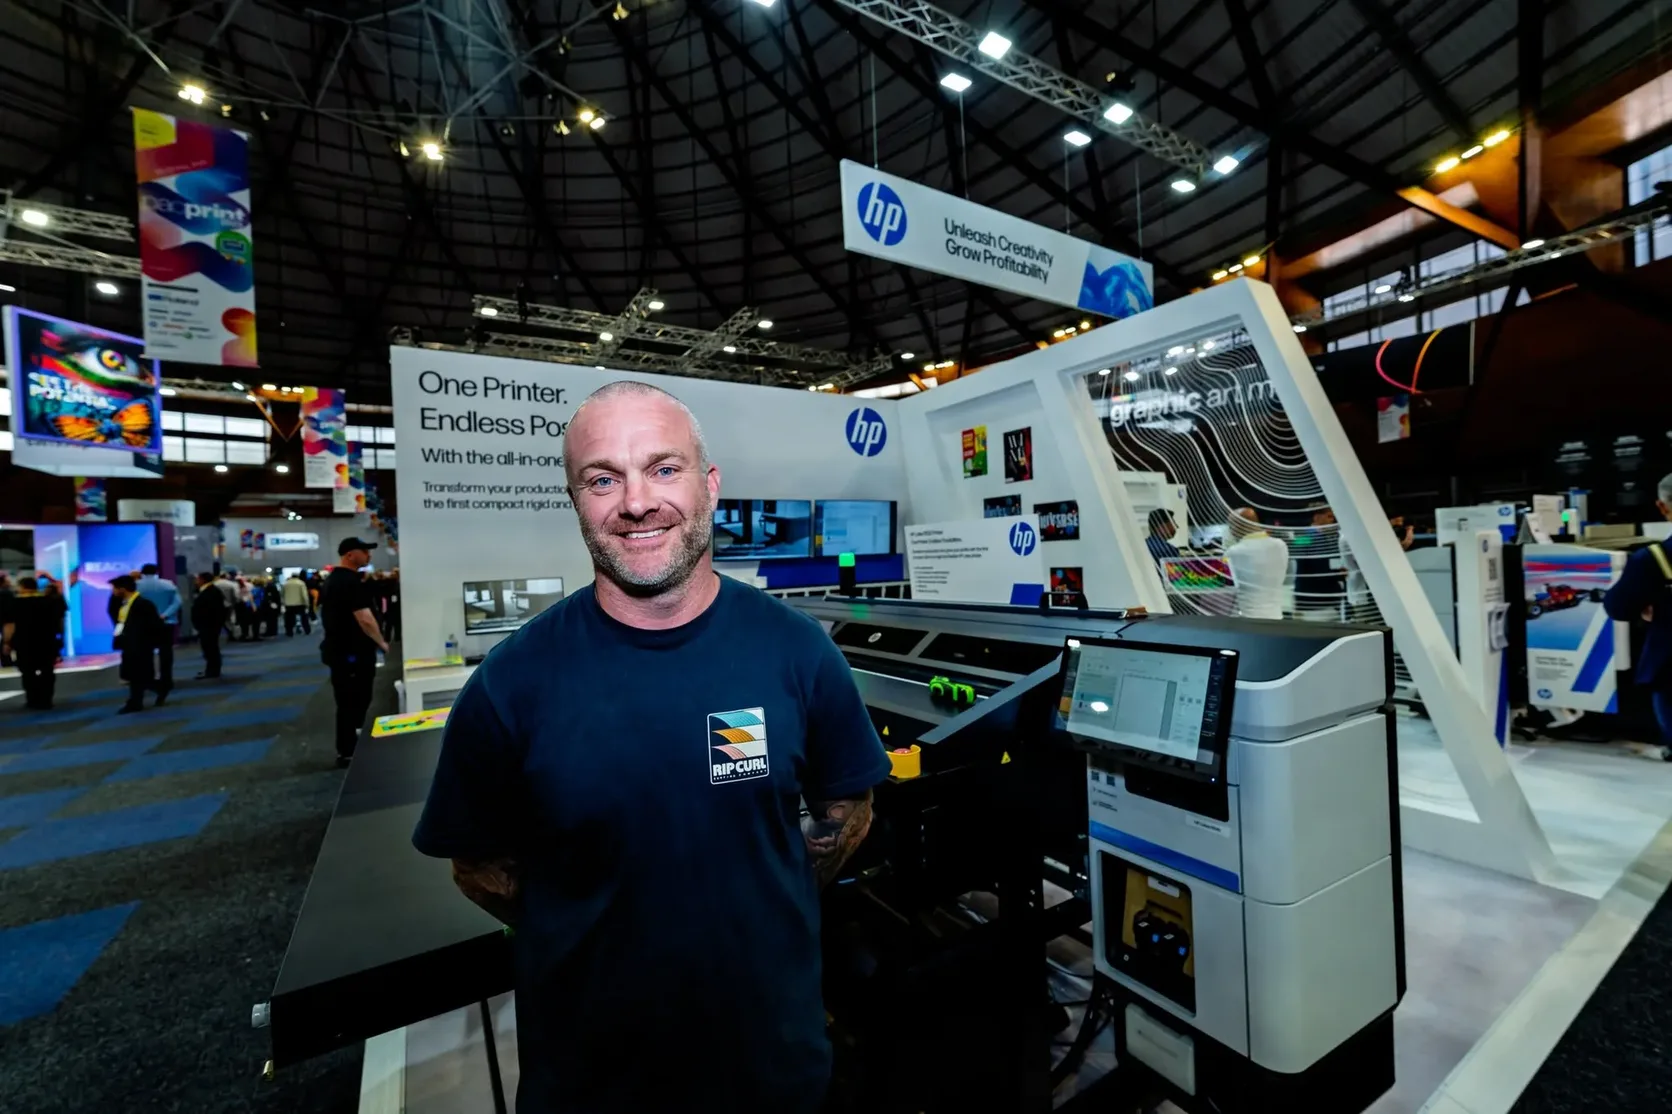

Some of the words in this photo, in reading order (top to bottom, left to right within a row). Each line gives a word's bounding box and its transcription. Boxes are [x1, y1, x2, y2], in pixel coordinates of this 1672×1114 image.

[859, 182, 906, 246] hp
[944, 217, 996, 249] Unleash
[998, 234, 1054, 269] Creativity
[945, 238, 981, 264] Grow
[983, 251, 1049, 285] Profitability
[418, 370, 478, 397] One
[483, 376, 568, 405] Printer.
[420, 407, 525, 436] Endless
[1110, 389, 1200, 428] graphic
[847, 407, 887, 457] hp
[421, 447, 462, 464] With
[466, 450, 494, 466] the
[496, 451, 564, 467] all-in-one
[422, 481, 486, 494] Transform
[487, 484, 514, 497] your
[423, 499, 445, 509] the
[446, 498, 470, 509] first
[472, 499, 526, 511] compact
[526, 498, 550, 512] rigid
[551, 499, 573, 510] and
[1009, 522, 1036, 556] hp
[712, 762, 735, 777] RIP
[735, 757, 767, 773] CURL
